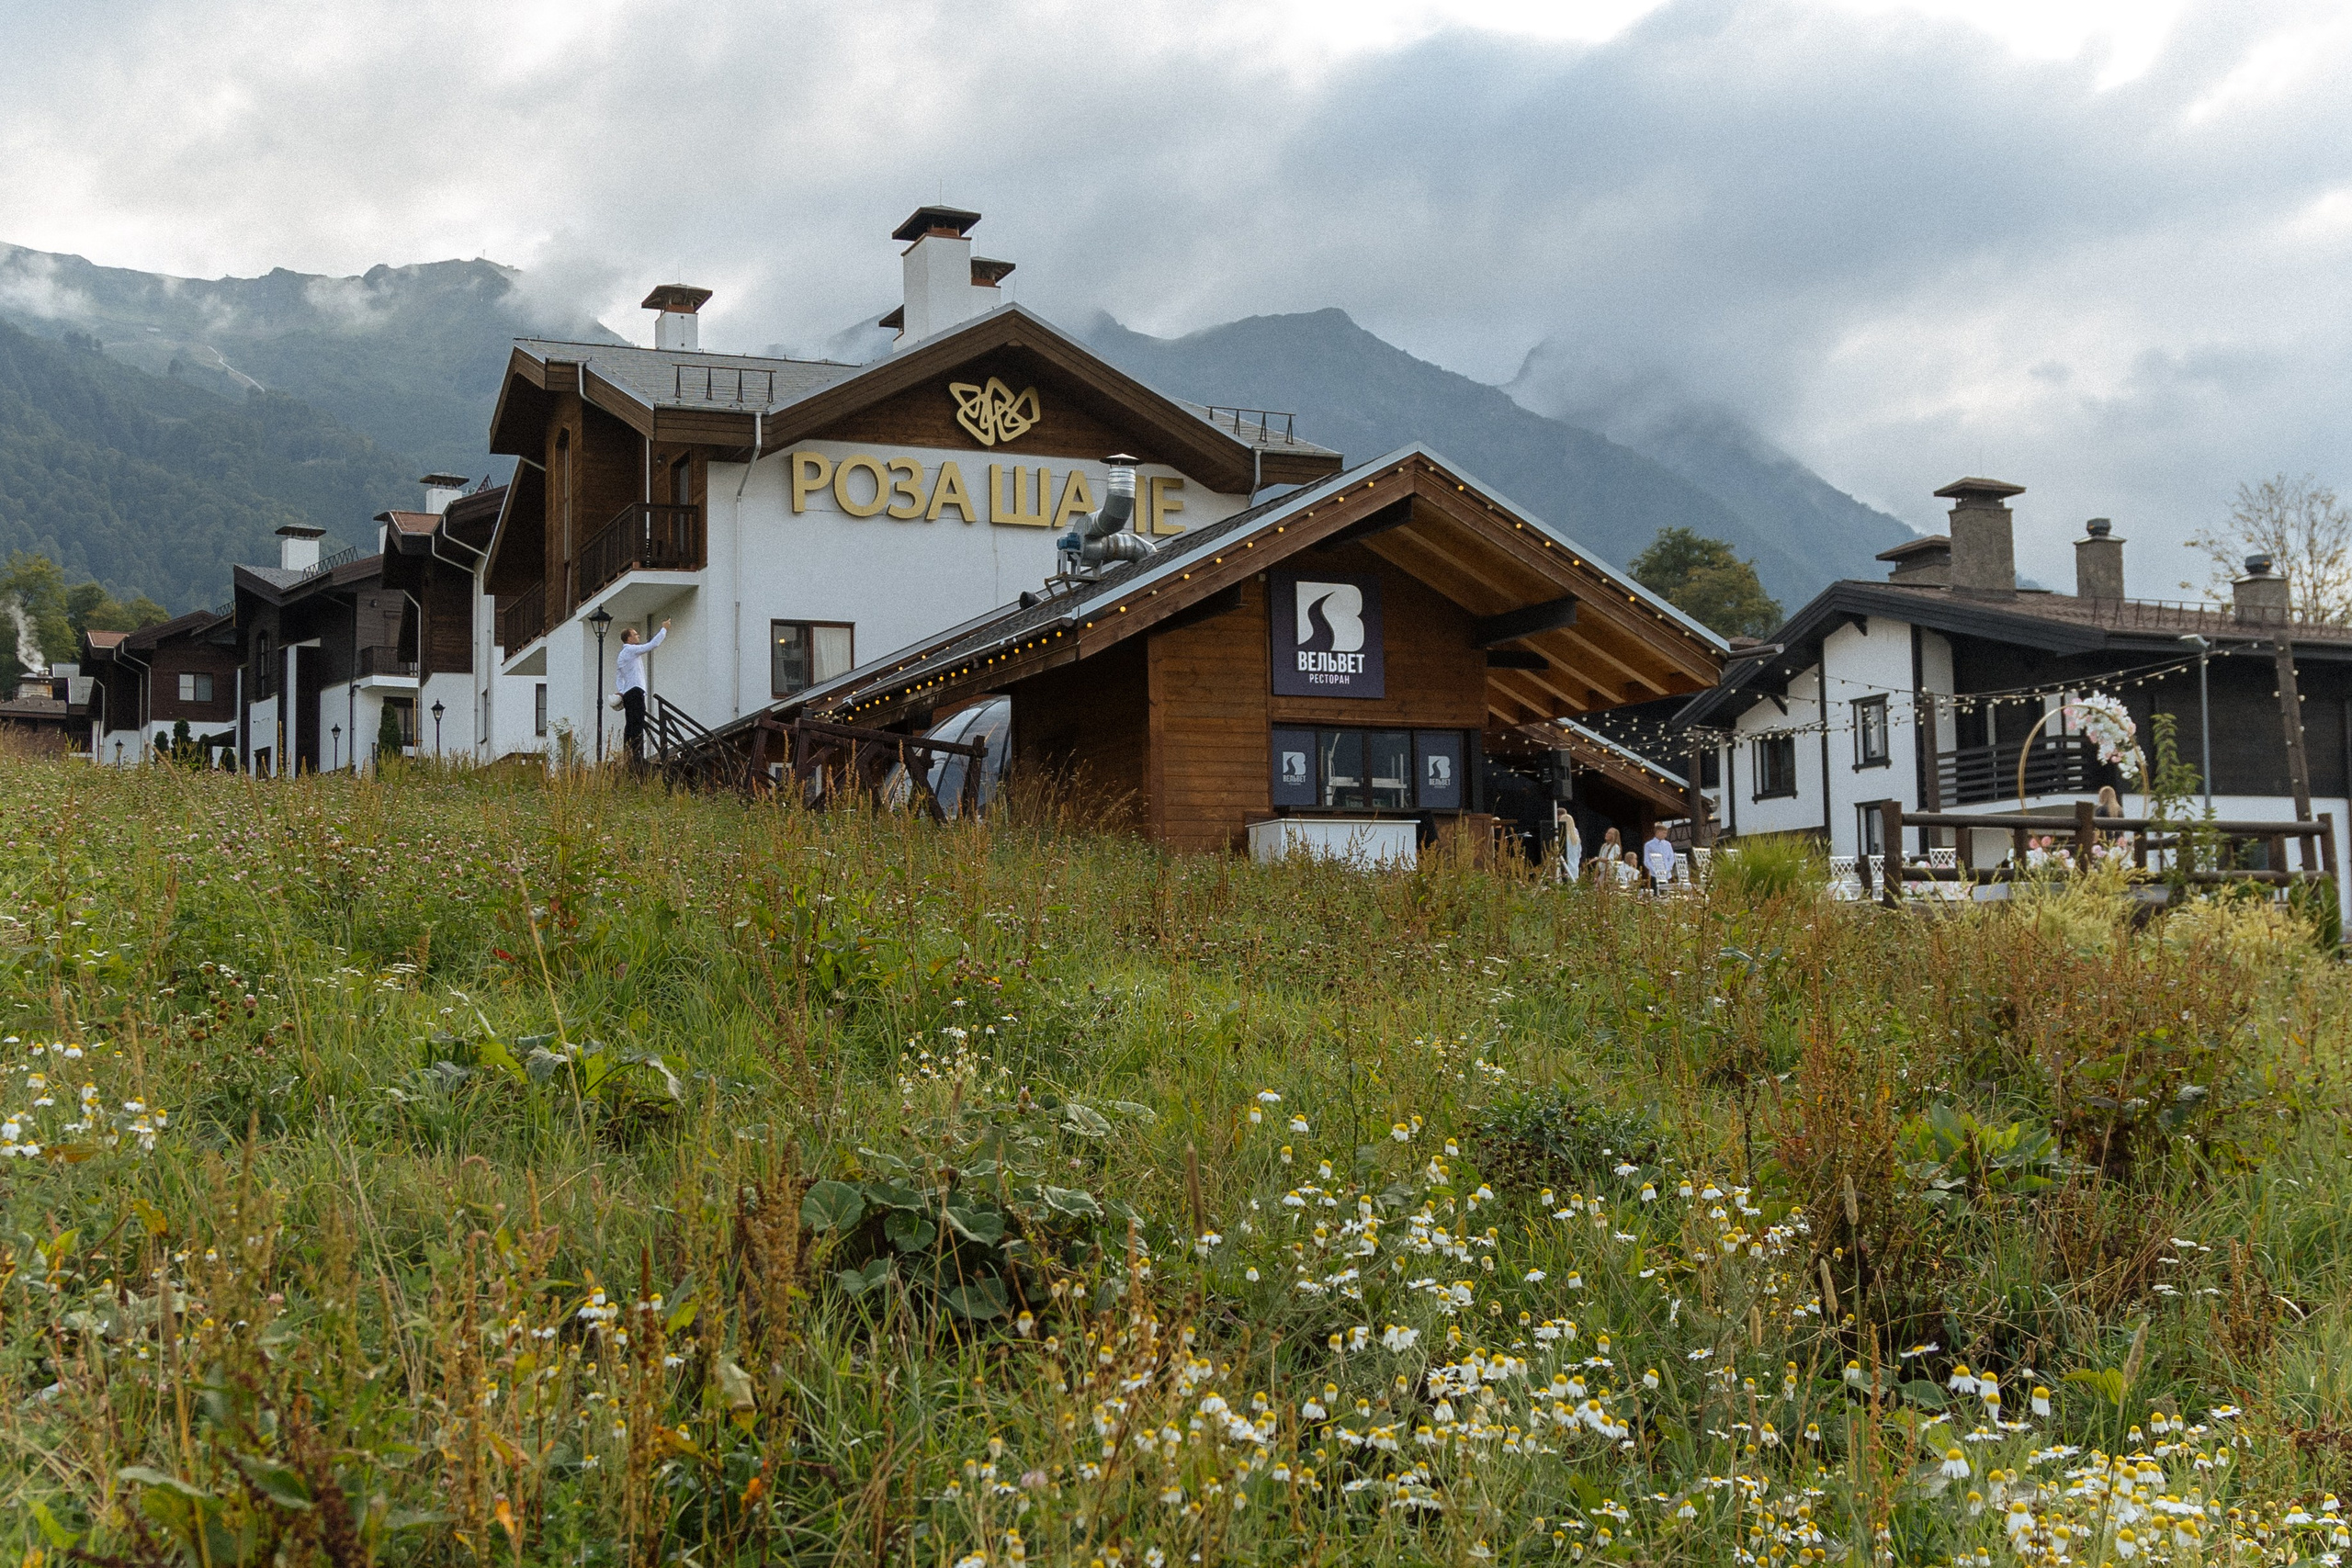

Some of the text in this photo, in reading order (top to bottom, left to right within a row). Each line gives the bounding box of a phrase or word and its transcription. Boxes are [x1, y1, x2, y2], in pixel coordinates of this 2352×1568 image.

[792, 451, 977, 523] РОЗА
[1297, 650, 1365, 673] ВЕЛЬВЕТ
[1309, 673, 1351, 684] РЕСТОРАН
